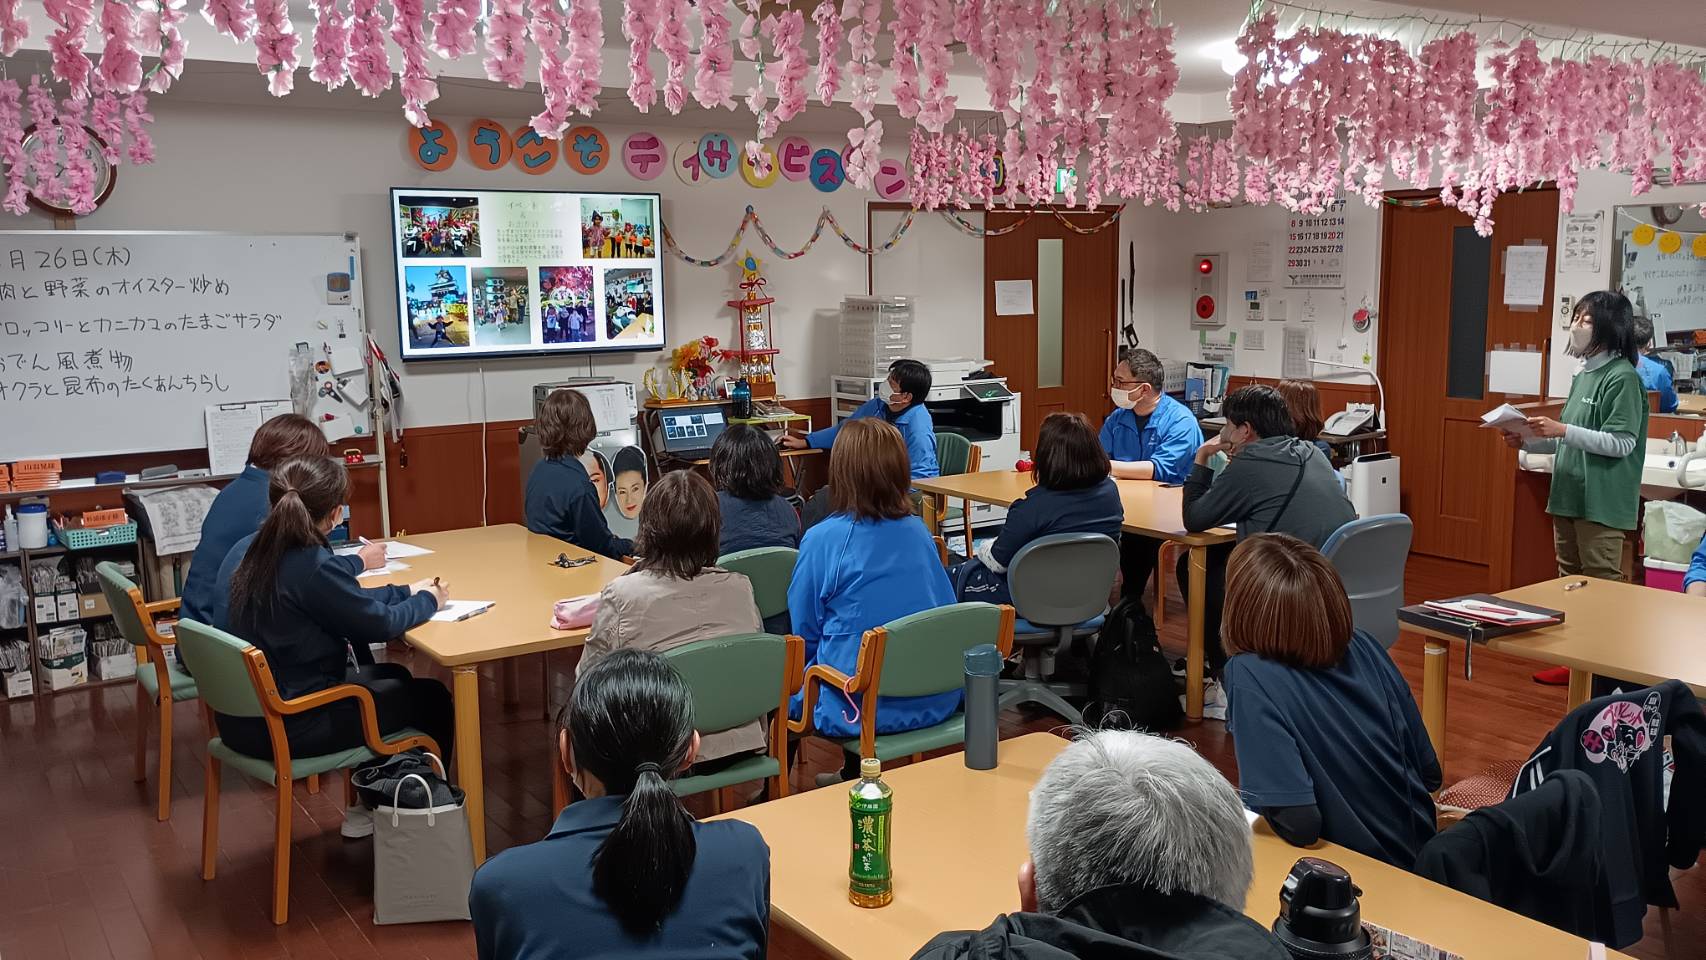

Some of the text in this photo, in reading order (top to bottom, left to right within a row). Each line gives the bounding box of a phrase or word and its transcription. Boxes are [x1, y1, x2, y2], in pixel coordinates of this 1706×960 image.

[419, 127, 603, 169] ようこそ
[1339, 204, 1344, 212] 7
[1291, 219, 1296, 228] 8
[1298, 219, 1303, 227] 9
[1305, 219, 1312, 227] 10
[1321, 218, 1328, 226] 12
[1329, 218, 1336, 226] 13
[1313, 232, 1319, 240] 18
[1320, 232, 1327, 240] 19
[1328, 232, 1335, 240] 20
[1327, 245, 1335, 253] 27
[1335, 245, 1343, 253] 28
[0, 273, 230, 300] 肉と野菜のオイスター炒め
[0, 312, 282, 337] ロッコリーとカニカマのたまごサラダ
